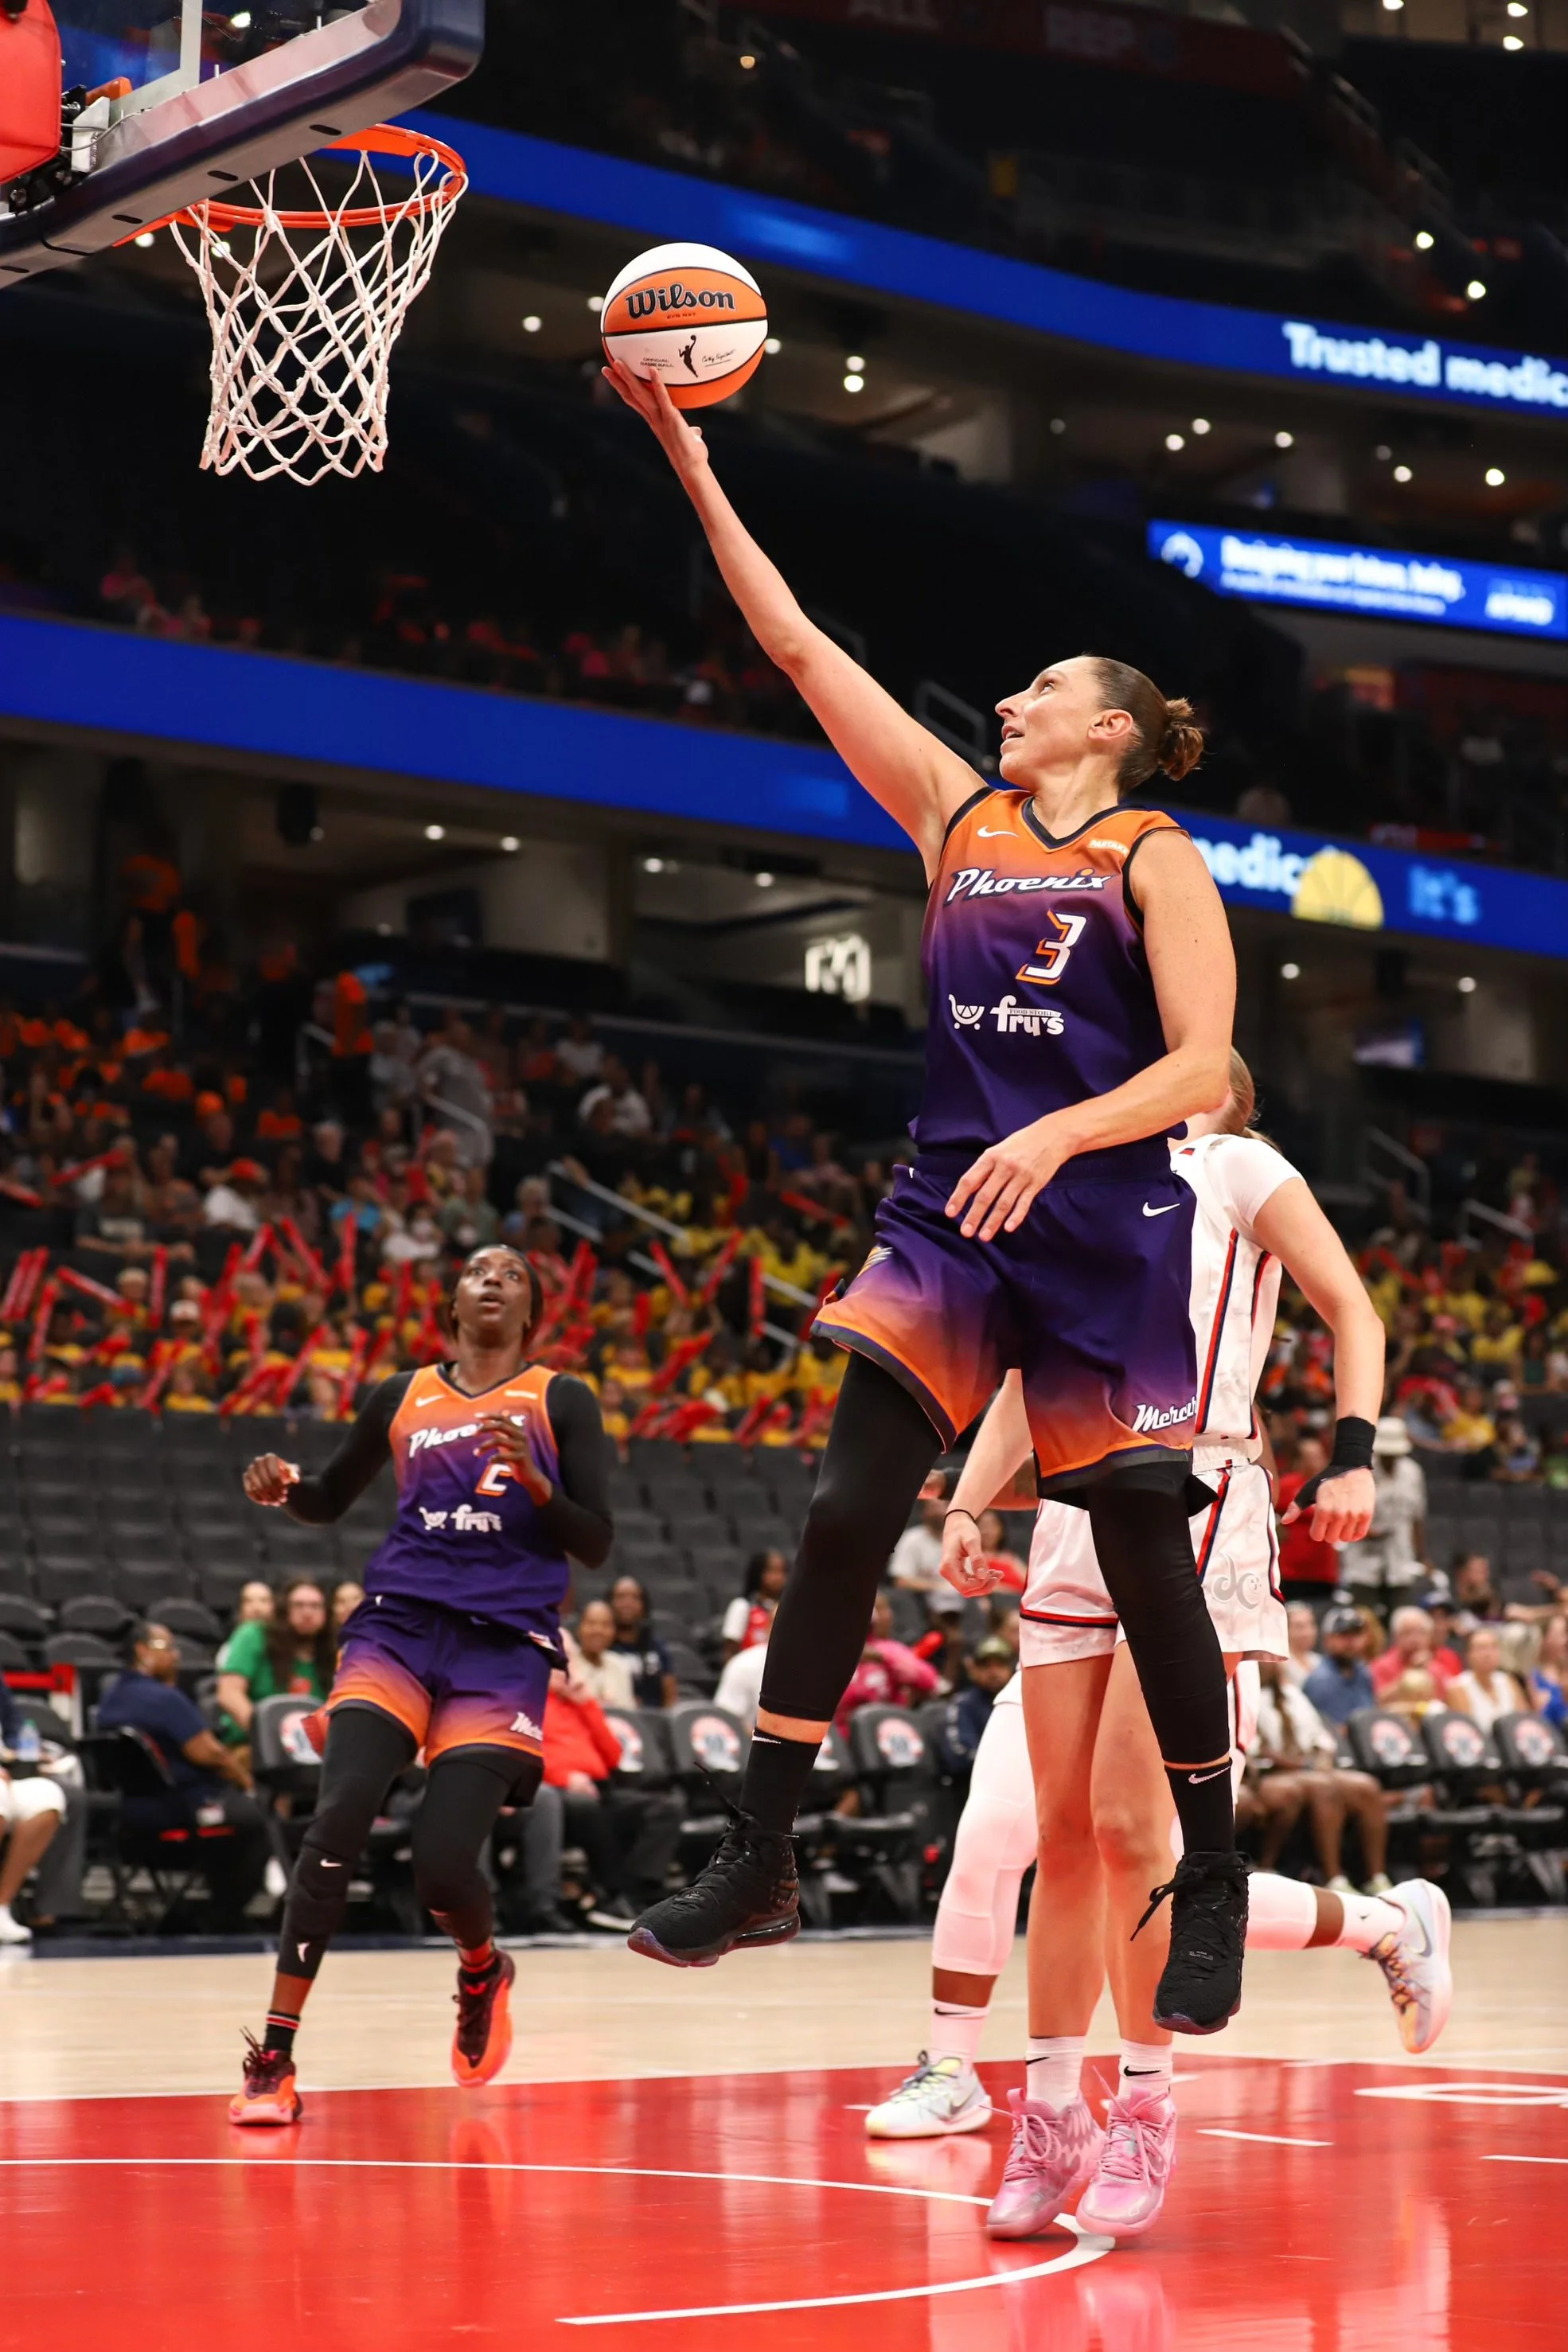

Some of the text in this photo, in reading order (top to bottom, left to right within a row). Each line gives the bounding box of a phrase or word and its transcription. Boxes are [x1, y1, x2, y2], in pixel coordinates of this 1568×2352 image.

[626, 283, 734, 318] Wilson
[1282, 321, 1441, 388] Trusted
[943, 868, 1112, 907] Phoenix
[1408, 864, 1480, 926] It's
[1016, 910, 1087, 985] 3
[989, 995, 1065, 1036] fry's
